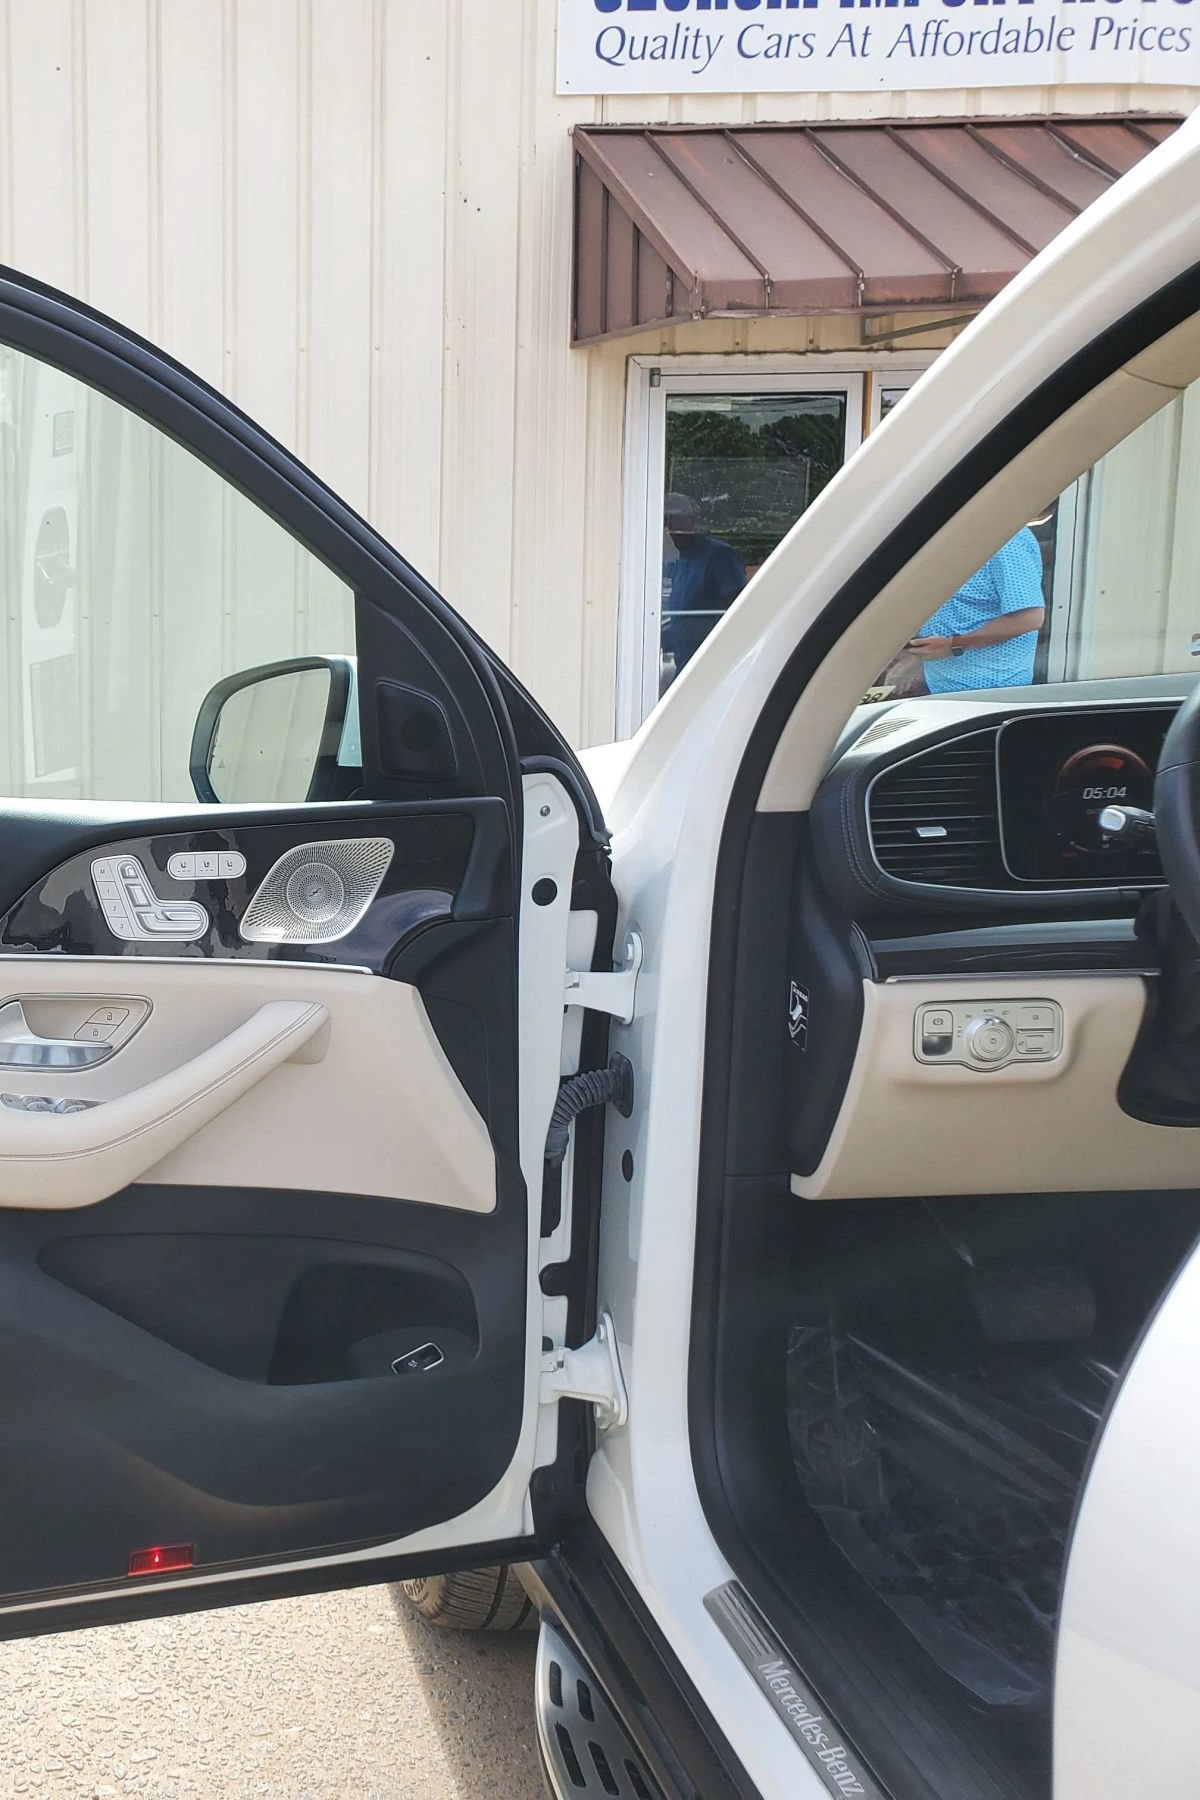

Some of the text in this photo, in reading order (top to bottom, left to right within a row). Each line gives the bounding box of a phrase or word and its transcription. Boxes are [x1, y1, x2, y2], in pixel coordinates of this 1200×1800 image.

[594, 15, 1192, 74] Quality Cars At Affordable Prices
[1082, 786, 1128, 800] 05:04
[758, 1659, 865, 1797] Mercedes-Benz
